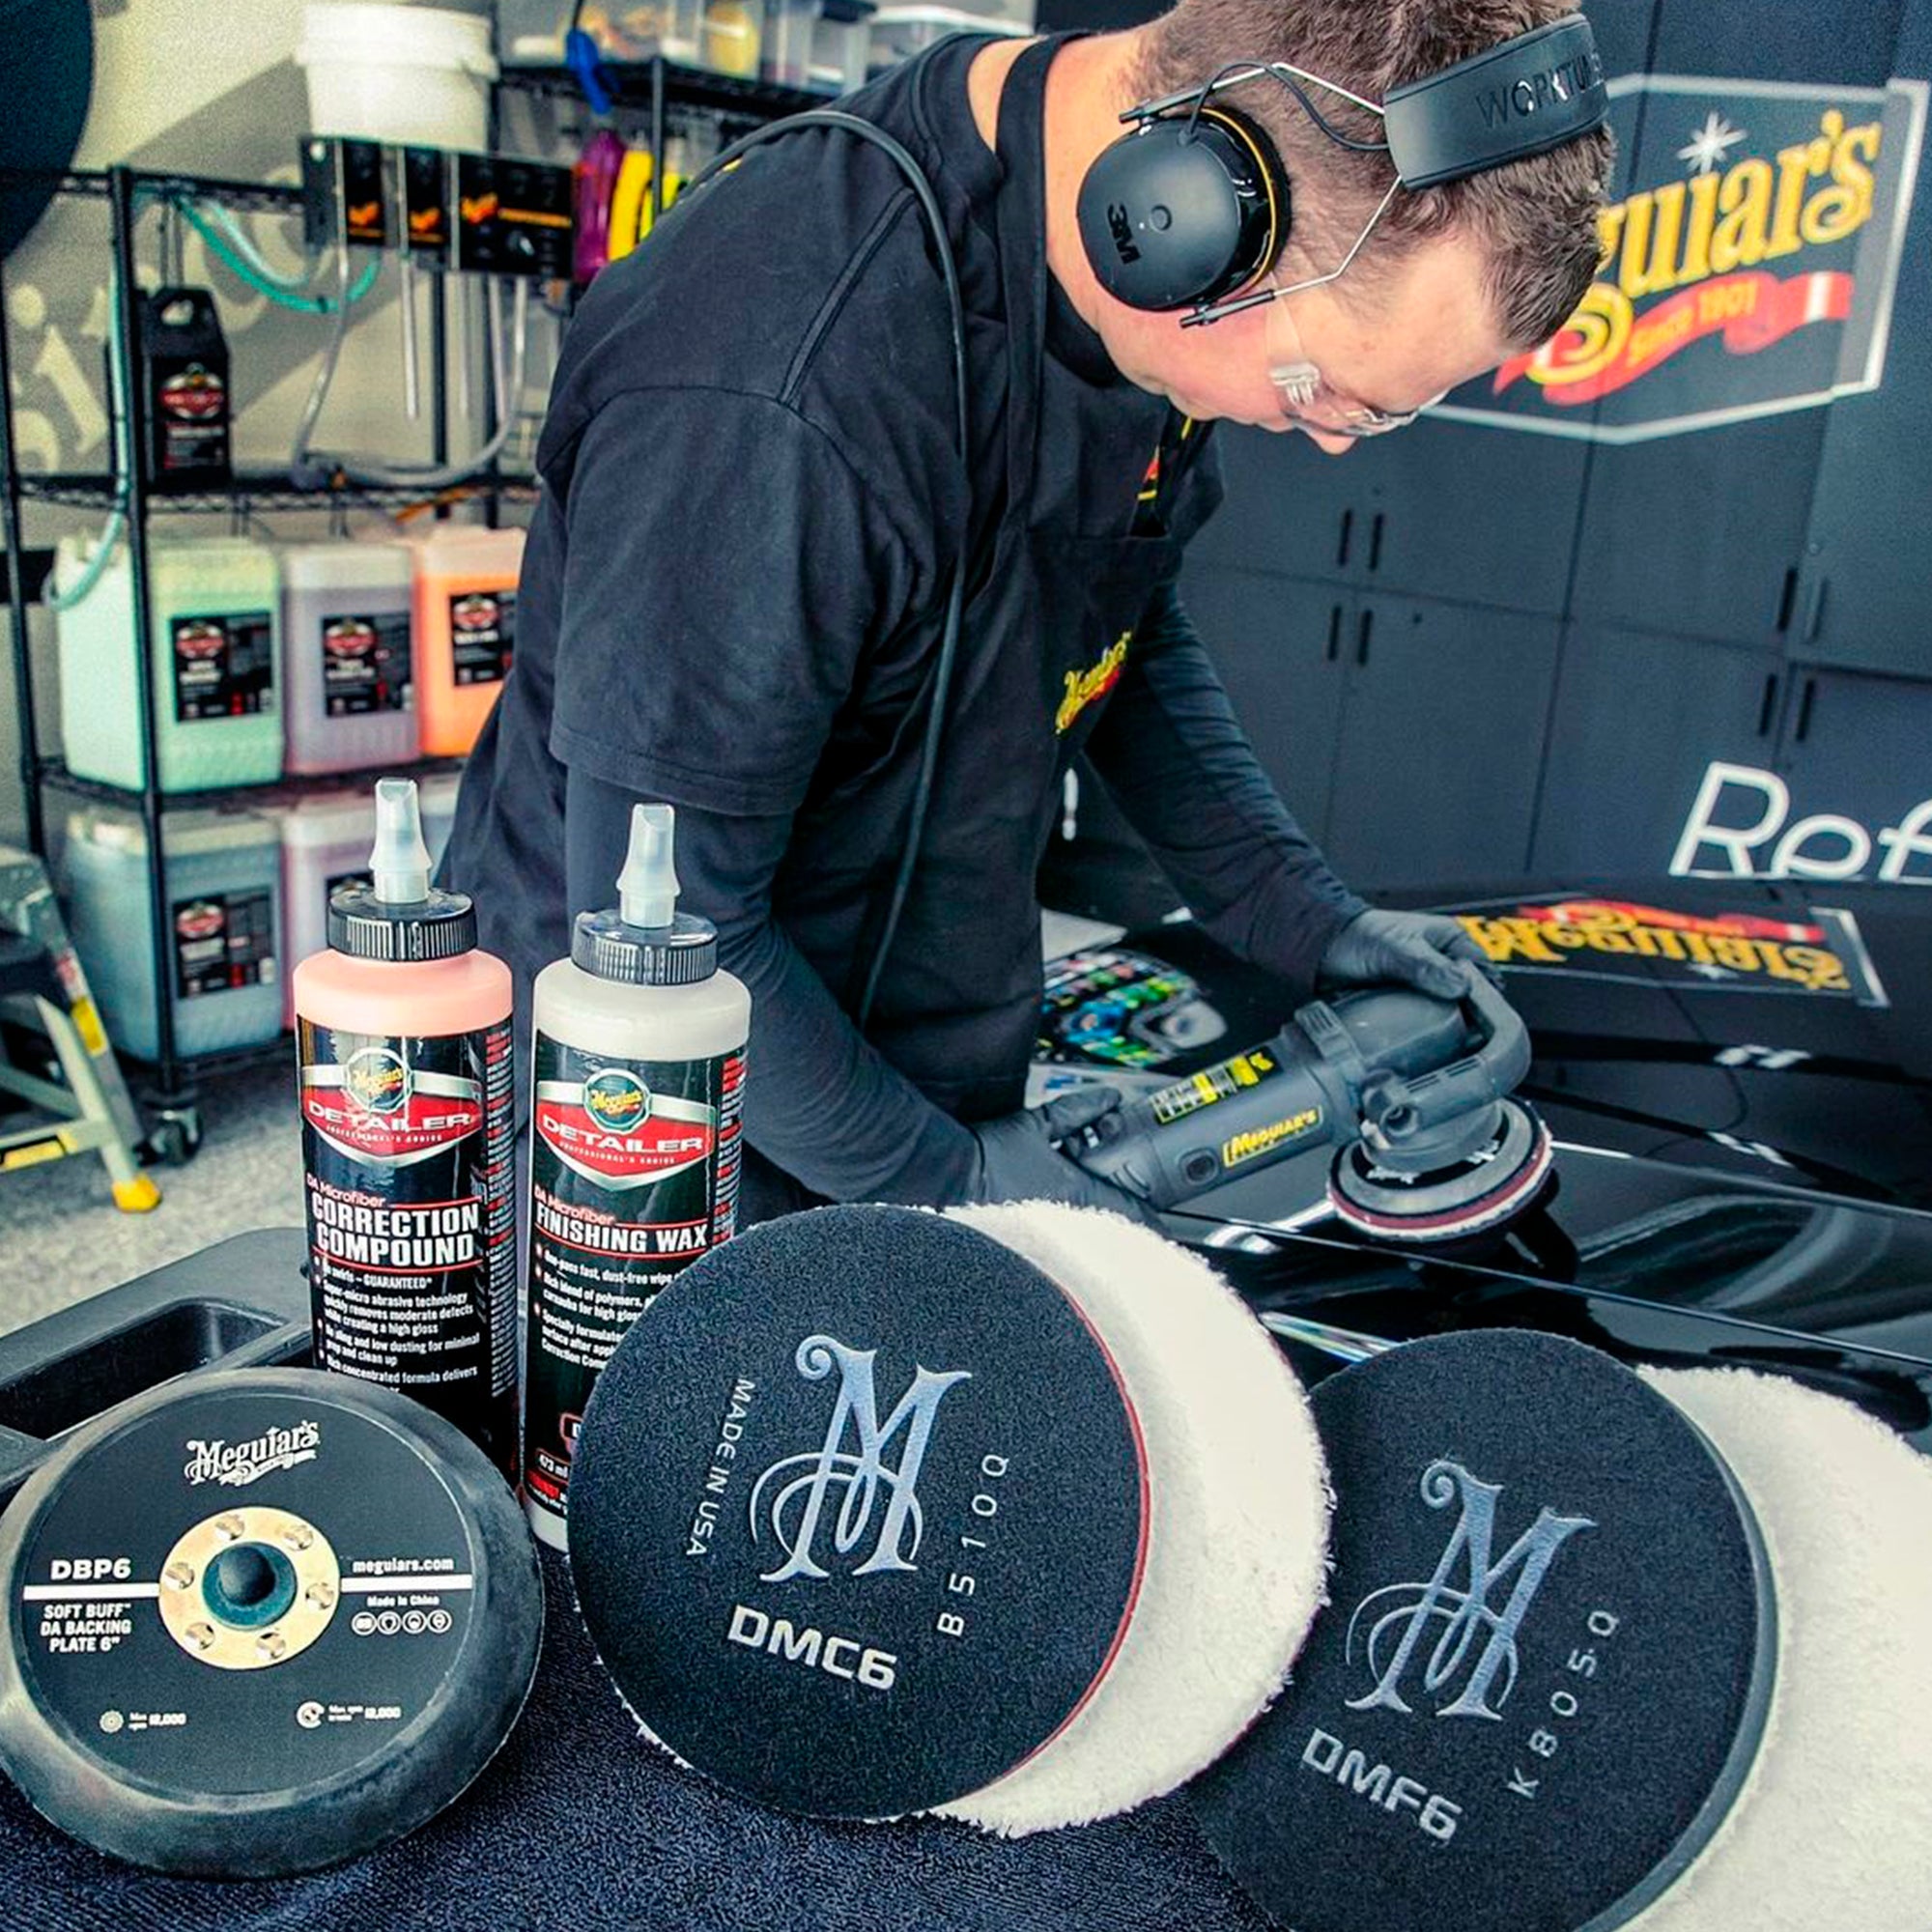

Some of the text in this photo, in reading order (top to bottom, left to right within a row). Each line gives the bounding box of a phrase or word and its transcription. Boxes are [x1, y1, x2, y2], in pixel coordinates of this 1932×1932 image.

[1107, 204, 1141, 265] 3M
[1526, 109, 1883, 384] guiar's
[308, 1100, 471, 1133] DETAILER
[542, 1114, 704, 1153] DETAILER
[312, 1191, 479, 1238] CORRECTION
[536, 1202, 708, 1253] FINISHING WAX
[316, 1222, 474, 1266] COMPOUND
[439, 1303, 474, 1321] defects
[183, 1419, 321, 1487] Meguiar's
[685, 1378, 756, 1557] MADE IN USA
[50, 1557, 132, 1580] DBP6
[352, 1556, 455, 1576] meguiars.com
[40, 1619, 132, 1636] DA BACKING
[43, 1604, 83, 1620] SOFT
[48, 1636, 97, 1653] PLATE
[727, 1604, 897, 1690] DMC6
[1301, 1726, 1463, 1840] DMF6
